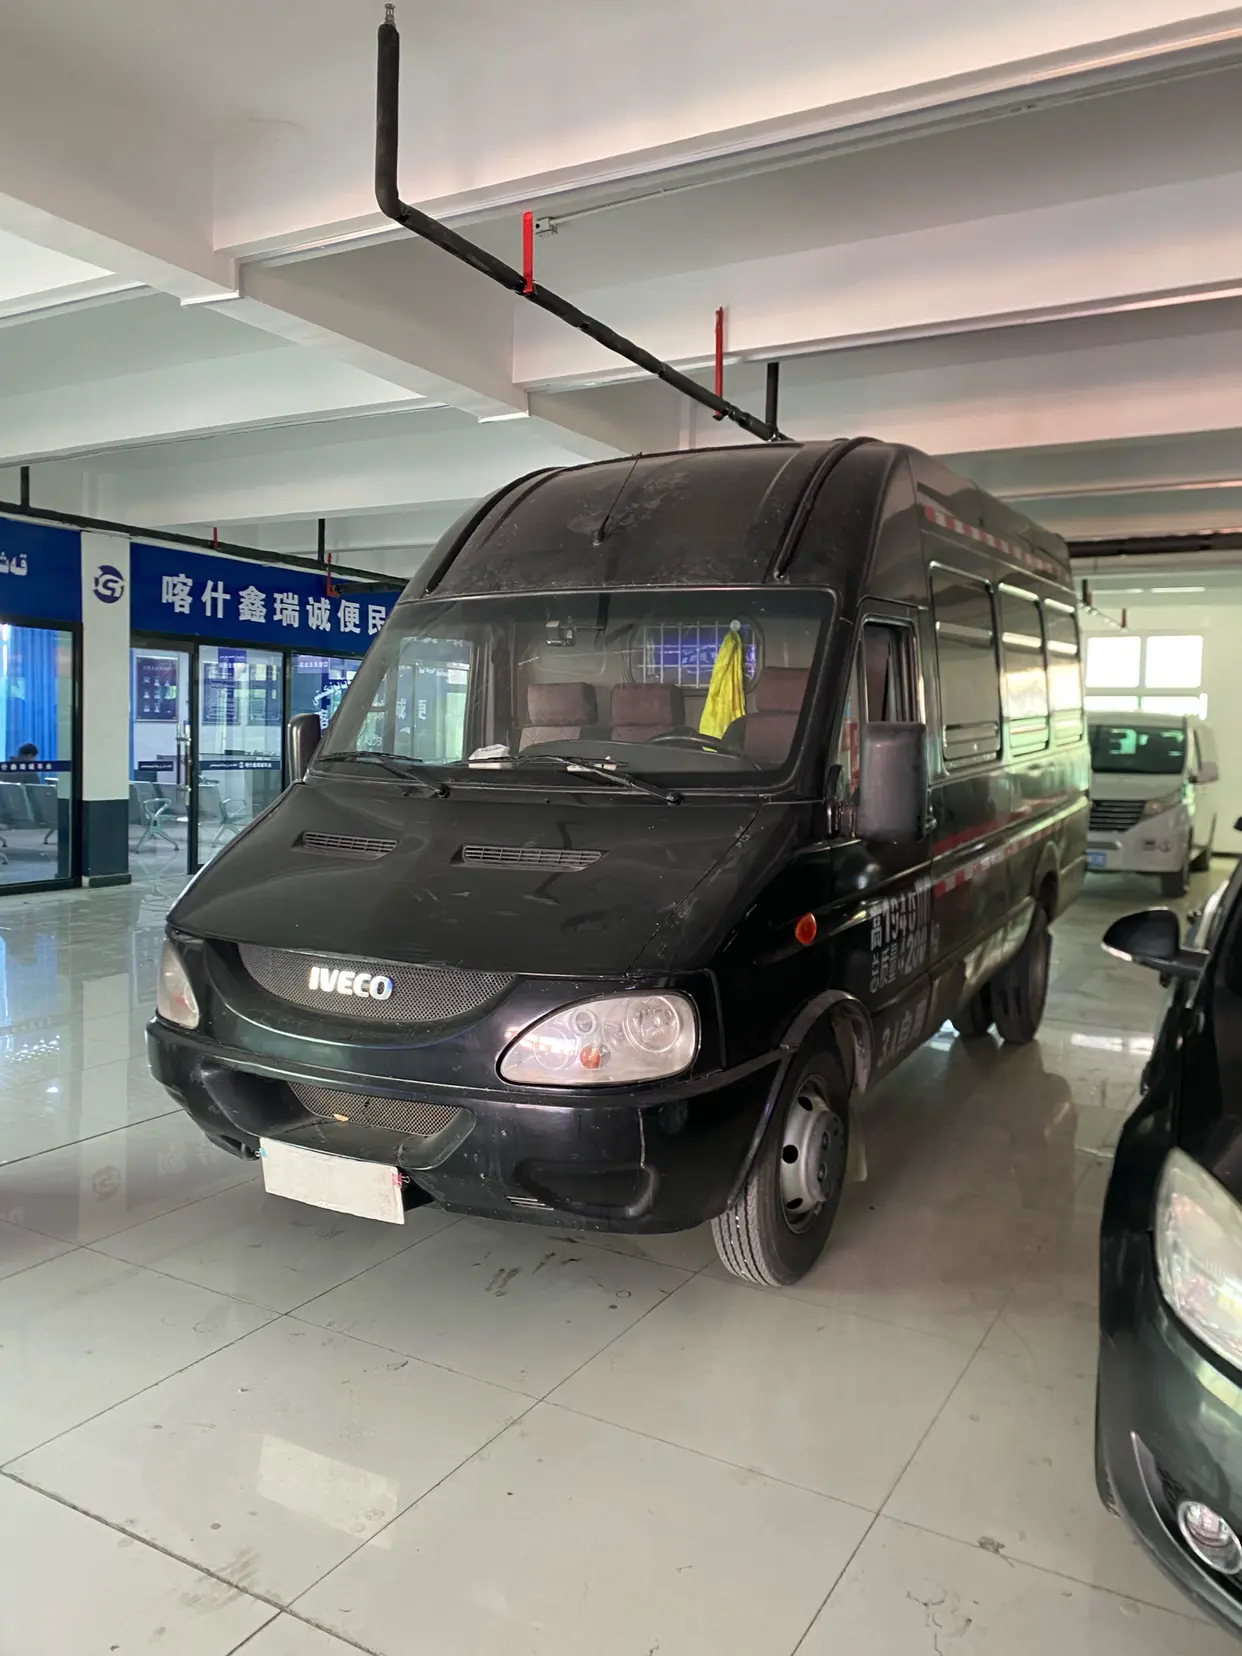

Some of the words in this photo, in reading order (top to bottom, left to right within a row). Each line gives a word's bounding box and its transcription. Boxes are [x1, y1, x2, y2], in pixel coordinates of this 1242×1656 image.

[161, 573, 388, 636] 喀什鑫瑞诚便民
[308, 966, 393, 1000] IVECO
